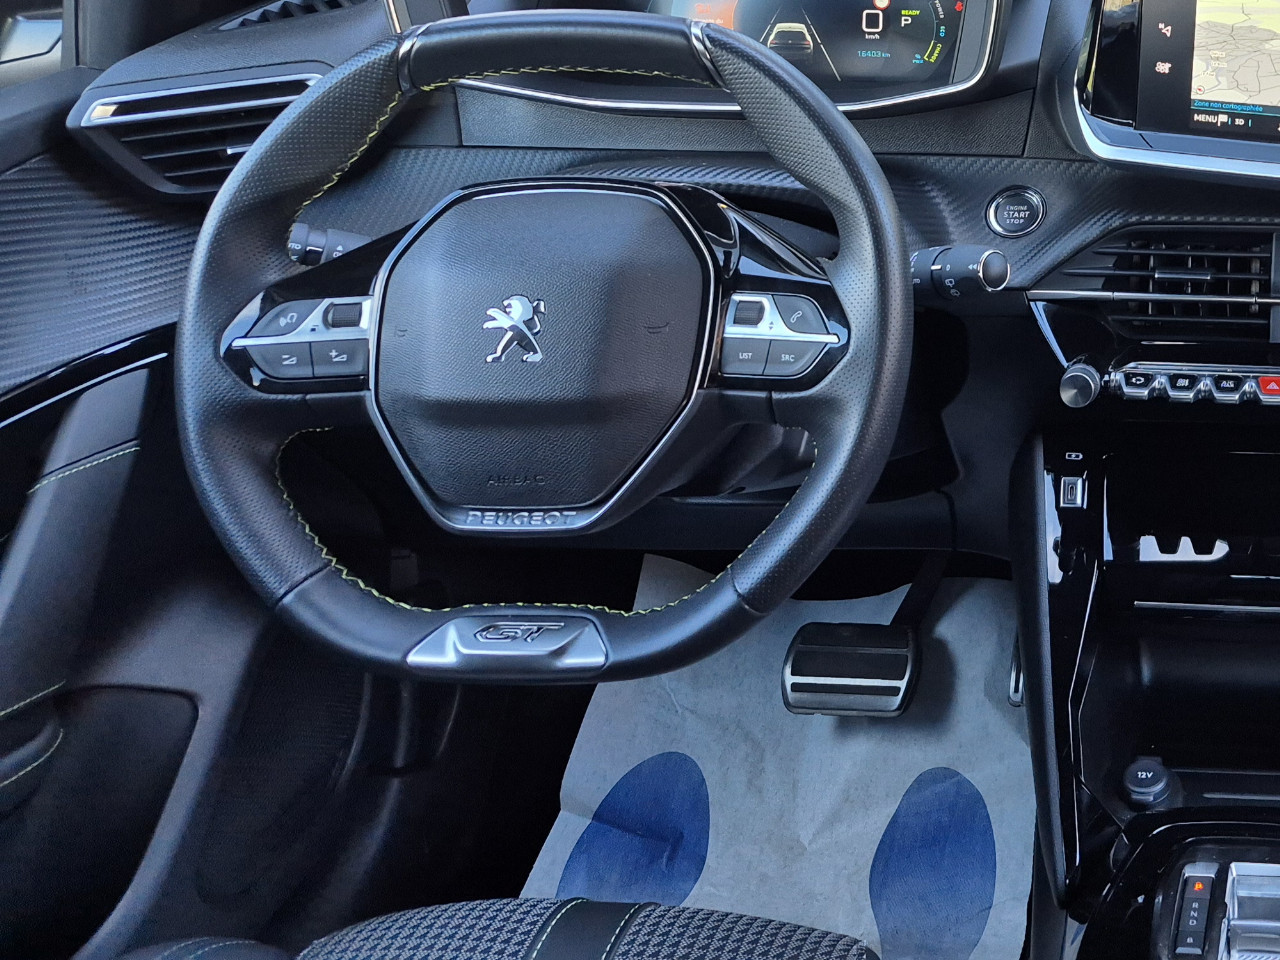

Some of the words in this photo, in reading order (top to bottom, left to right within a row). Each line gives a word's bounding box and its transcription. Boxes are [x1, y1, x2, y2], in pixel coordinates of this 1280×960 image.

[861, 9, 883, 33] 0
[901, 16, 912, 27] P
[1193, 113, 1218, 123] MENU
[738, 352, 753, 360] LIST
[780, 354, 795, 362] SRC
[465, 511, 577, 525] PEUGEOT
[1136, 771, 1155, 779] 12V
